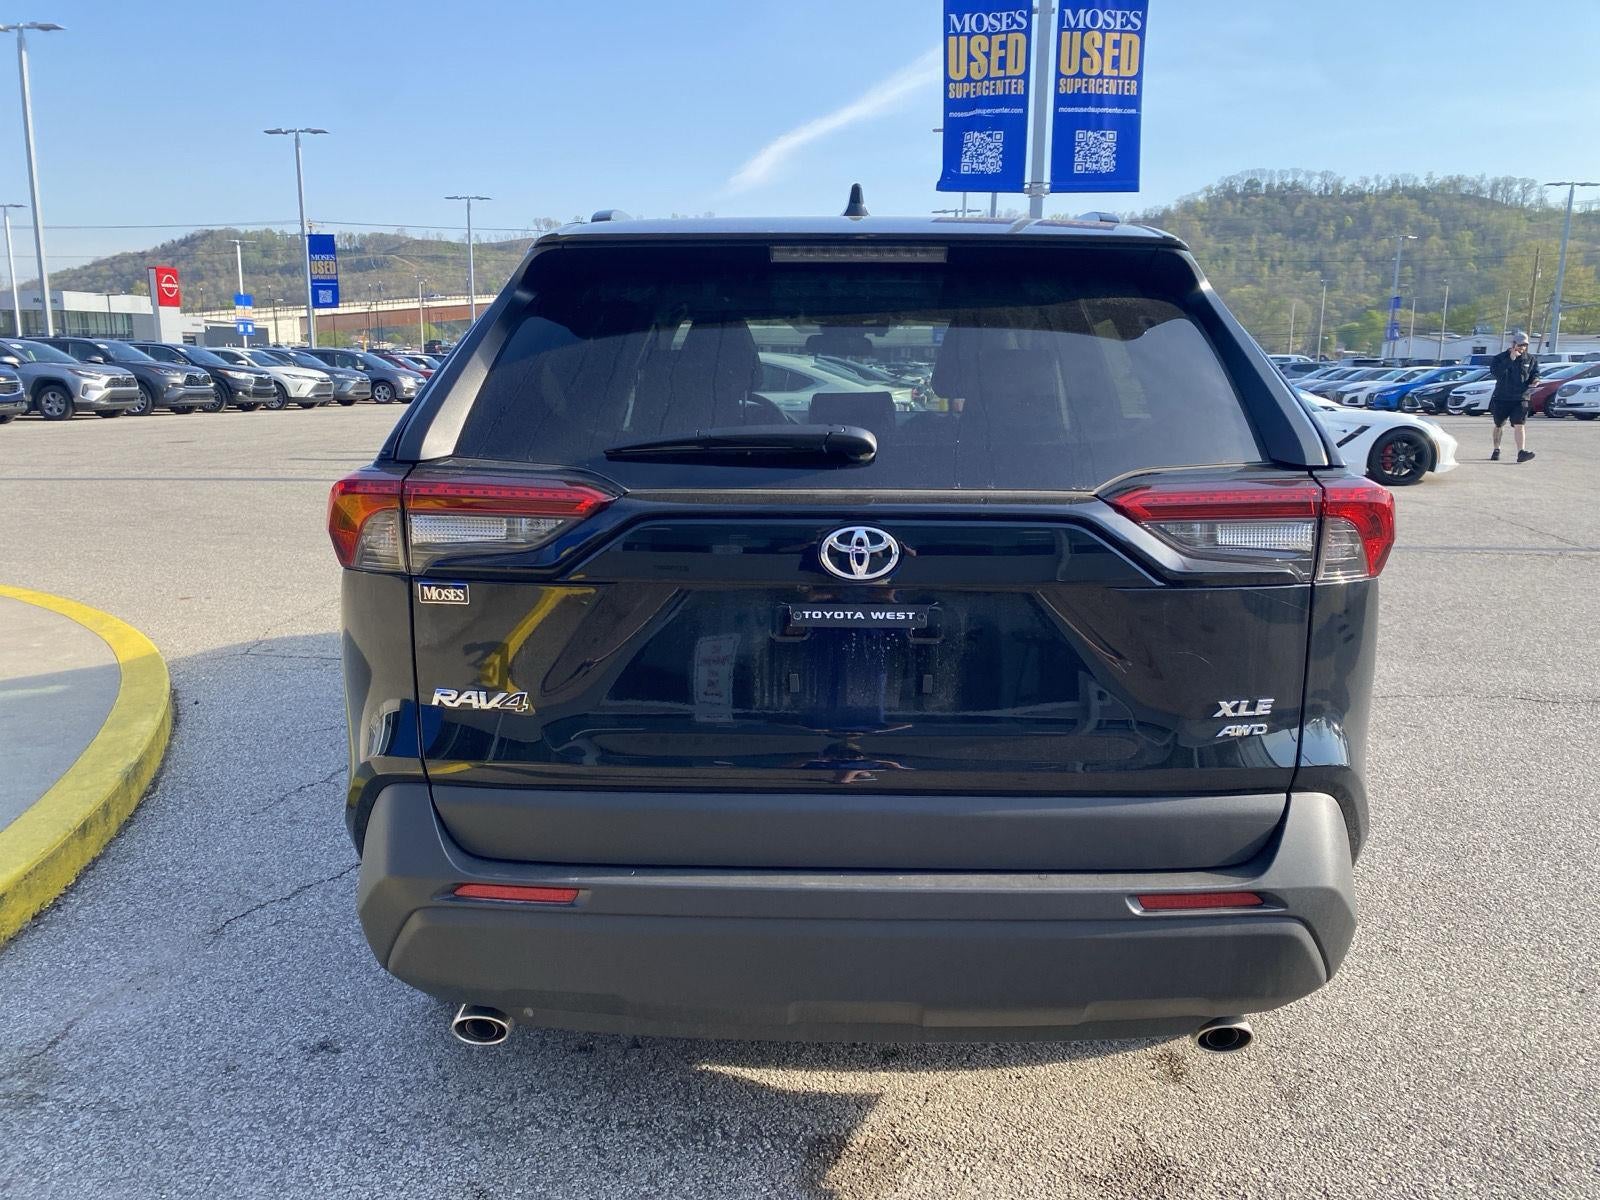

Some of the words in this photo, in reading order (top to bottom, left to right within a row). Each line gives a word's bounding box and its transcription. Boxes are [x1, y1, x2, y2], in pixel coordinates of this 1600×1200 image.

[948, 10, 1028, 34] MOSES
[1062, 8, 1143, 31] MOSES
[948, 32, 1027, 81] USED
[1059, 31, 1141, 77] USED
[948, 79, 1025, 99] SUPERCENTER
[1059, 78, 1138, 96] SUPERCENTER
[1058, 106, 1137, 114] mosesusedsupercenter.com
[311, 260, 337, 275] USED
[423, 586, 465, 601] MOSES
[802, 611, 865, 619] TOYOTA
[870, 611, 916, 620] WEST
[431, 688, 529, 712] RAV4
[1212, 698, 1276, 718] XLE
[1216, 723, 1268, 738] AWD
